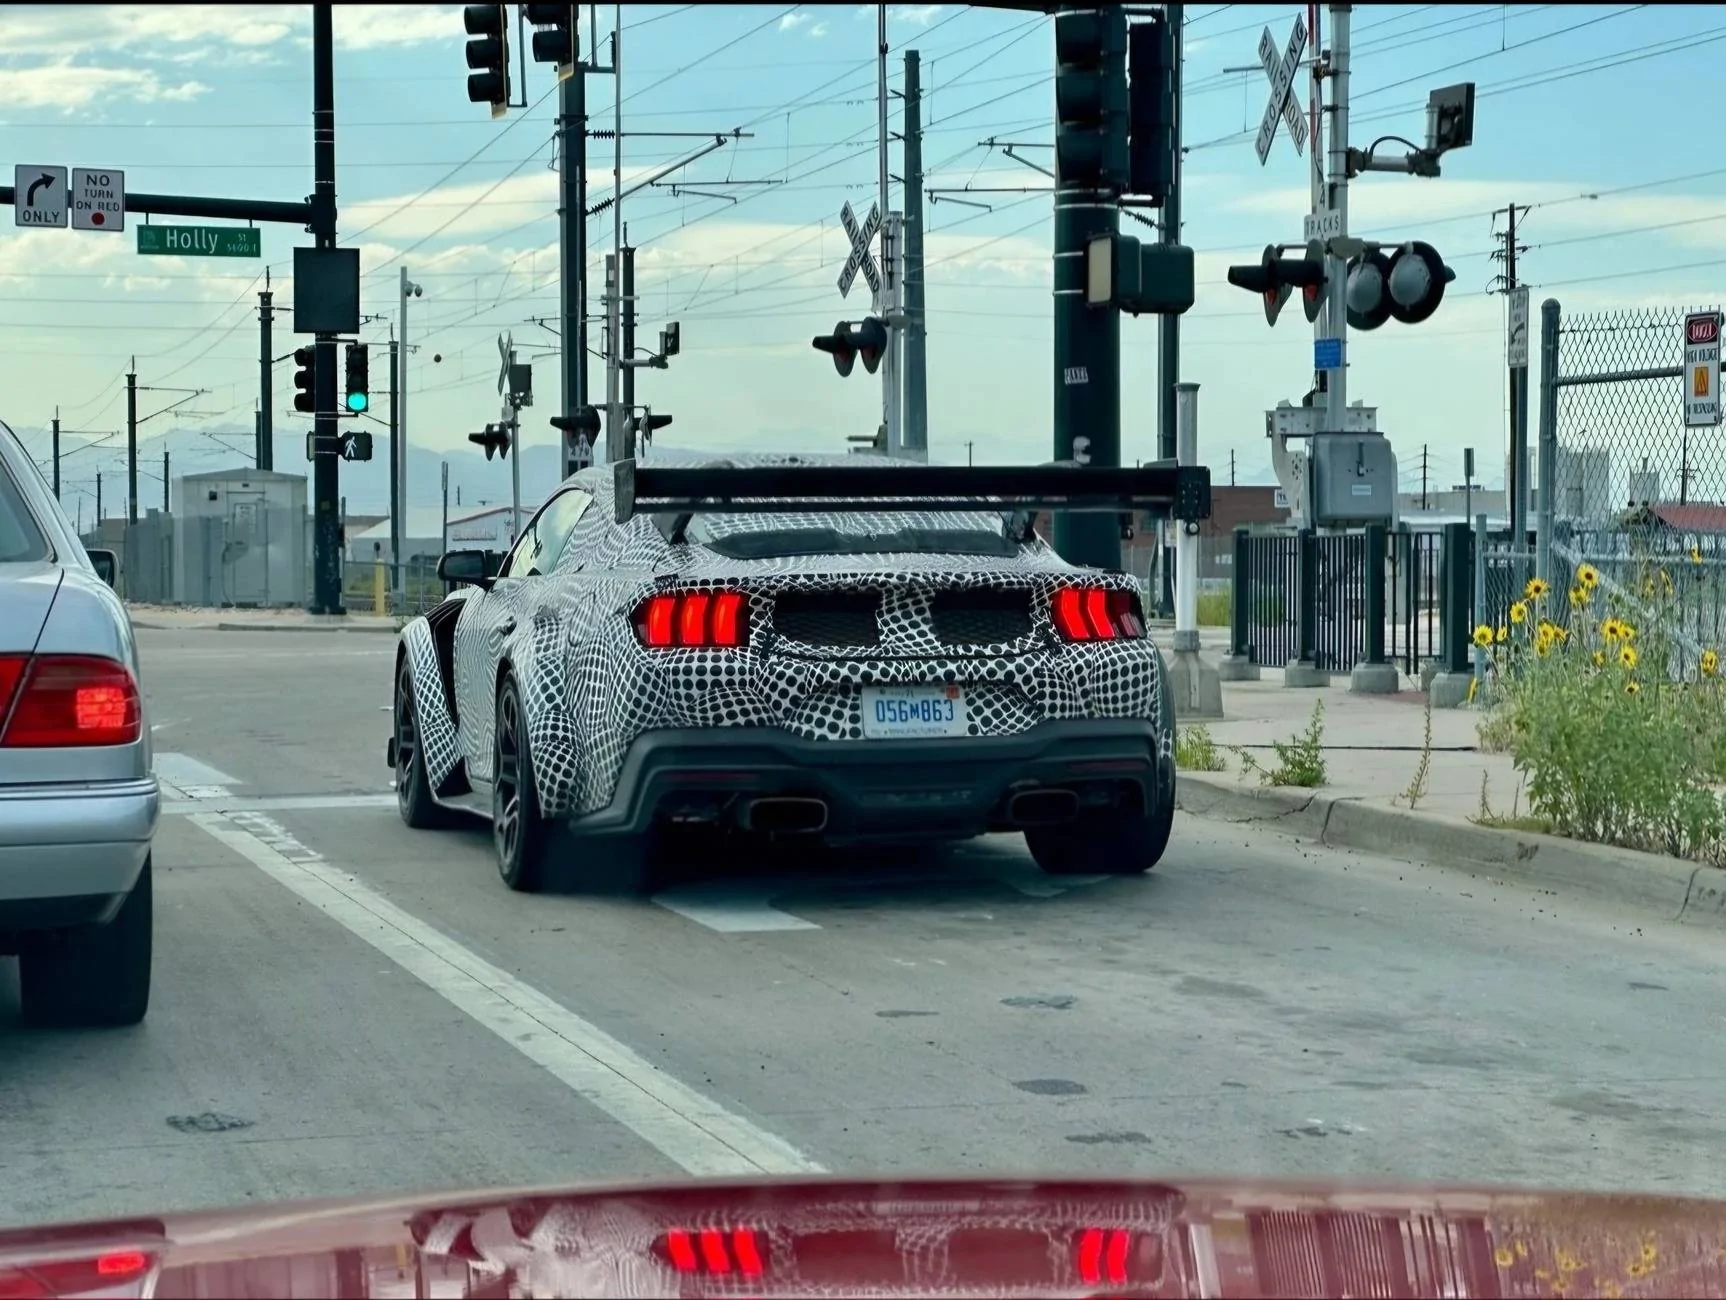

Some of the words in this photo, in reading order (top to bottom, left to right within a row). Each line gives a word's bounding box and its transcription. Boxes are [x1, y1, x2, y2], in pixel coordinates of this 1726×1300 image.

[1260, 35, 1280, 86] RAIL
[1257, 21, 1304, 154] CROSSING
[86, 174, 110, 187] NO
[84, 188, 114, 199] TURN
[22, 210, 60, 223] ONLY
[76, 201, 92, 210] ON
[97, 202, 120, 212] RED
[1306, 214, 1339, 236] TRACKS
[166, 228, 218, 254] Holly
[840, 206, 879, 290] CROSSING
[875, 700, 954, 722] 056M863
